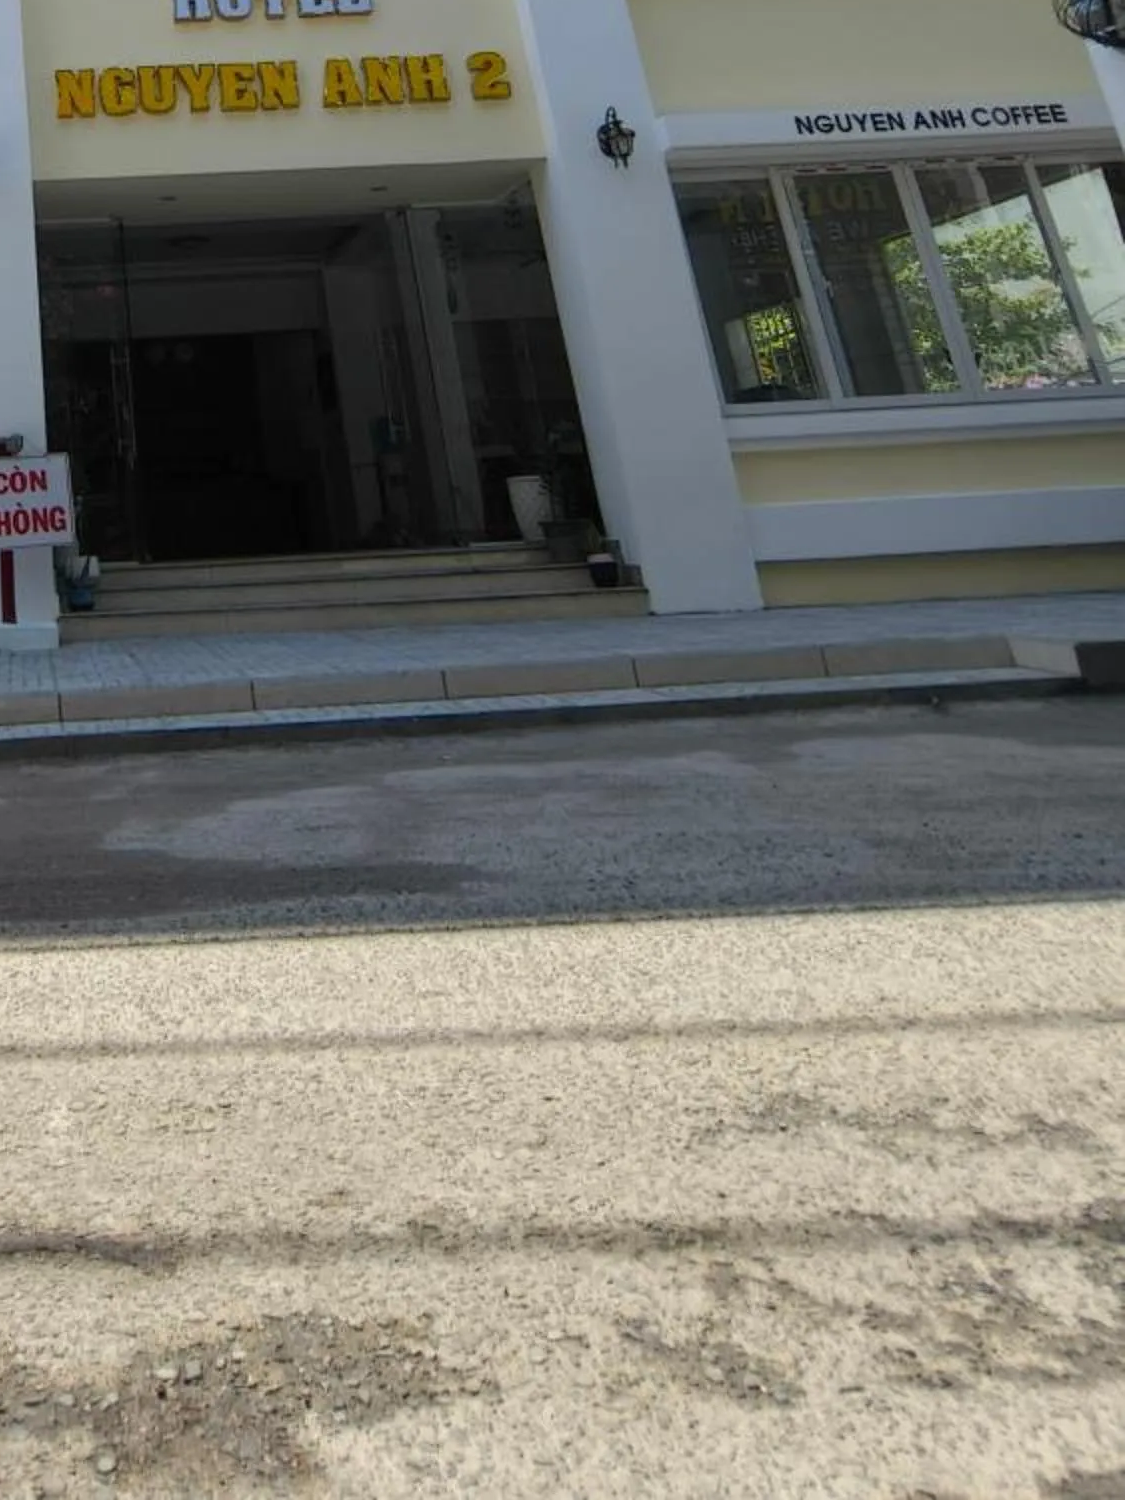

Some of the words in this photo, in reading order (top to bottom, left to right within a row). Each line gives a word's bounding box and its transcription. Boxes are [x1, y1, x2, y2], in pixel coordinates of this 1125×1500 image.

[54, 60, 300, 118] NGUYEN
[323, 53, 452, 108] ANH
[467, 51, 512, 101] 2
[794, 112, 906, 136] NGUYEN
[913, 109, 966, 130] ANH
[971, 104, 1068, 128] COFFEE
